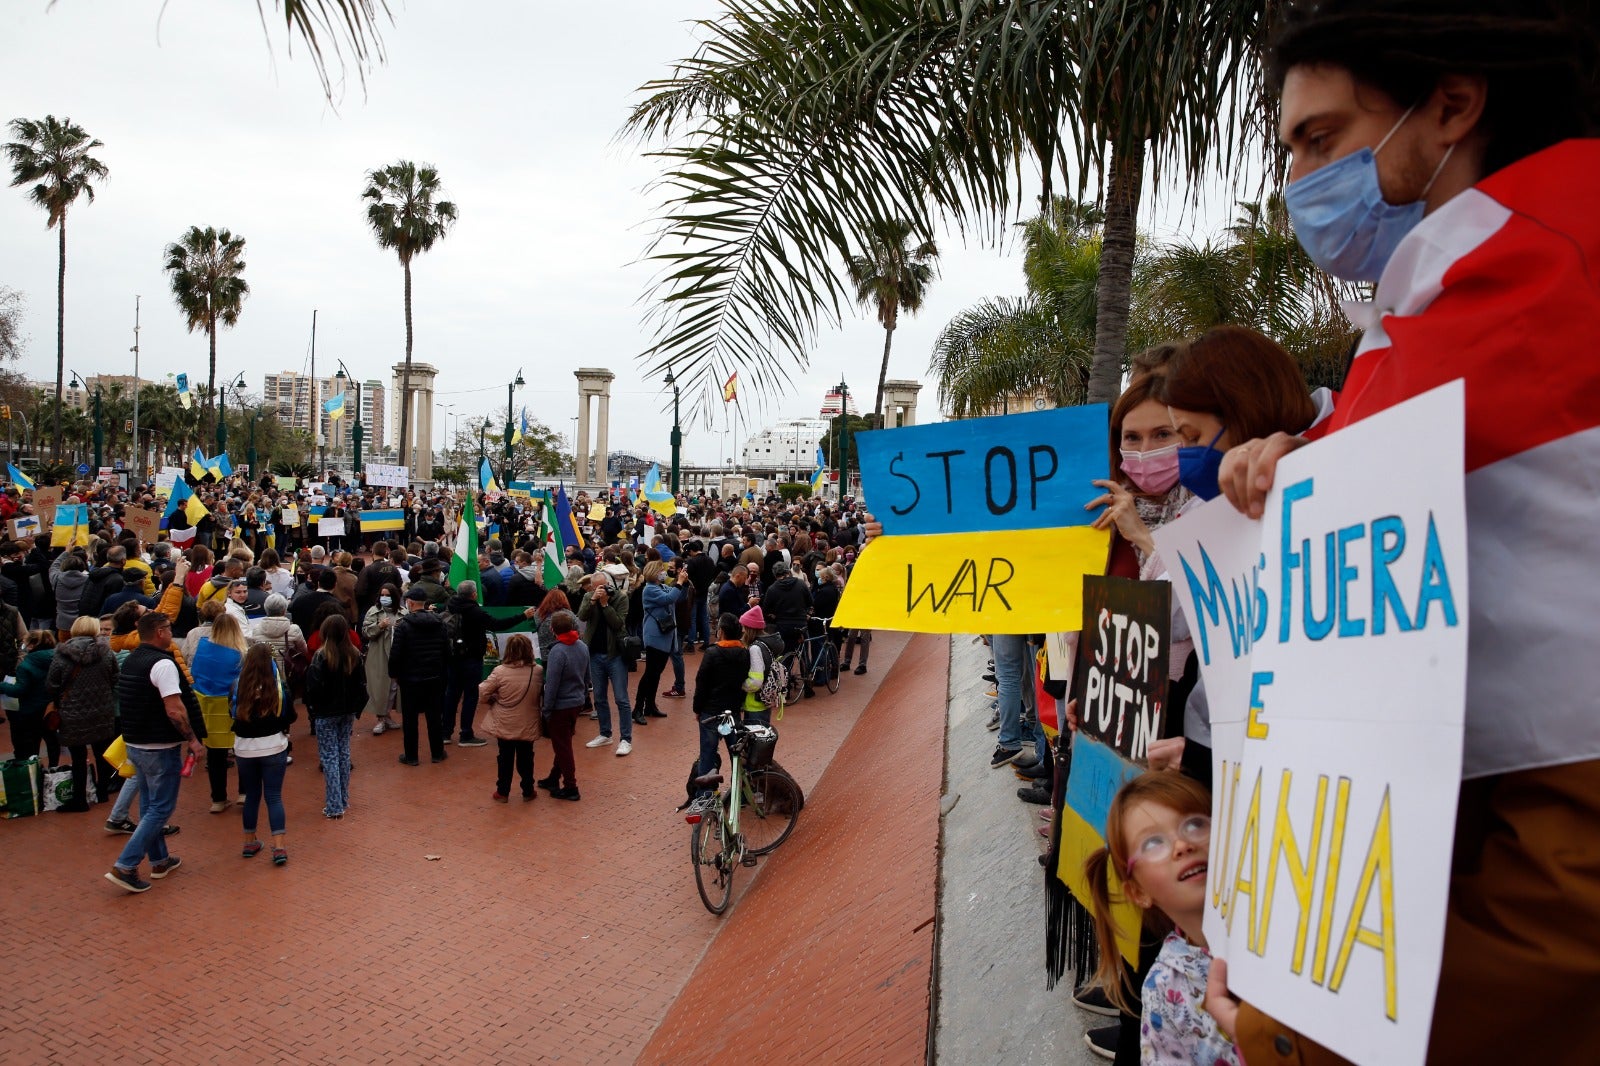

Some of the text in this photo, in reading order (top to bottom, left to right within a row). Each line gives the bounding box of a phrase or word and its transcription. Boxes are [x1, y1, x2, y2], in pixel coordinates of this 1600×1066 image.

[889, 444, 1059, 517] STOP
[906, 557, 1015, 615] WAR
[1278, 477, 1459, 644] FUERA
[1094, 607, 1160, 683] STOP
[1246, 671, 1274, 740] E
